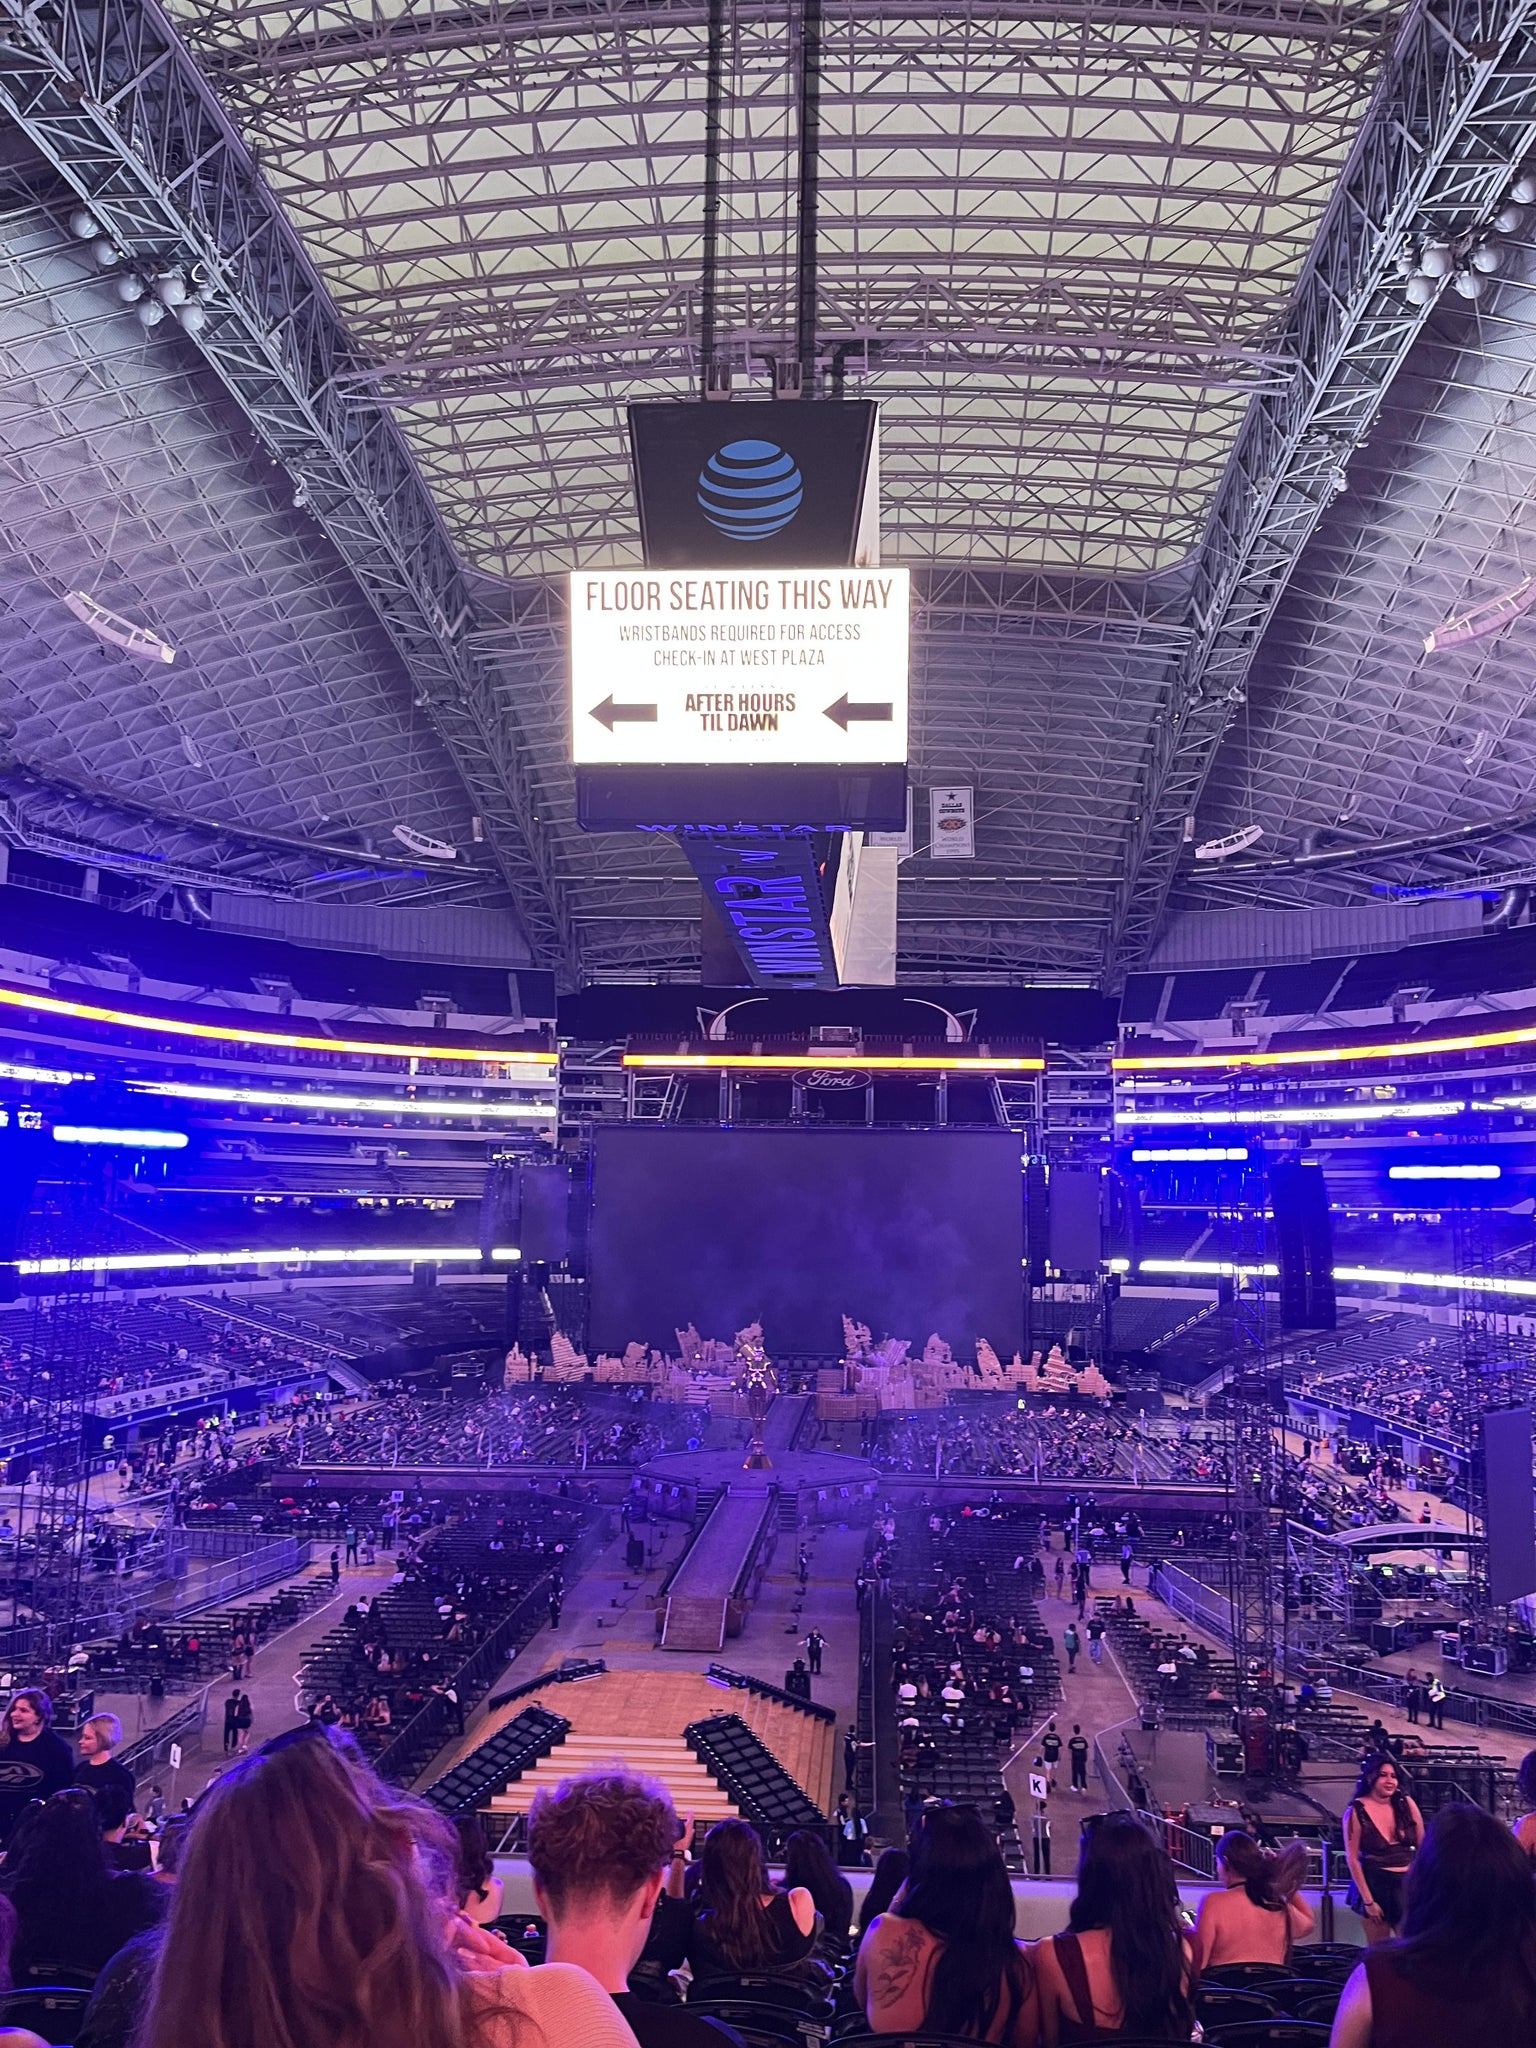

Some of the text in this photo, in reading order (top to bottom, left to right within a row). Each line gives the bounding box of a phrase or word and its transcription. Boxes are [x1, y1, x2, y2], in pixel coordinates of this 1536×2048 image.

[587, 579, 893, 611] FLOOR SEATING THIS WAY
[619, 623, 861, 642] WRISTBANDS REQUIRED FOR ACCESS
[654, 649, 825, 666] CHECK-IN AT WEST PLAZA
[685, 693, 796, 712] AFTER HOURS
[700, 713, 778, 731] TIL DAWN
[714, 875, 824, 974] WINSTAR
[807, 1069, 856, 1086] Ford
[1033, 1779, 1042, 1793] K
